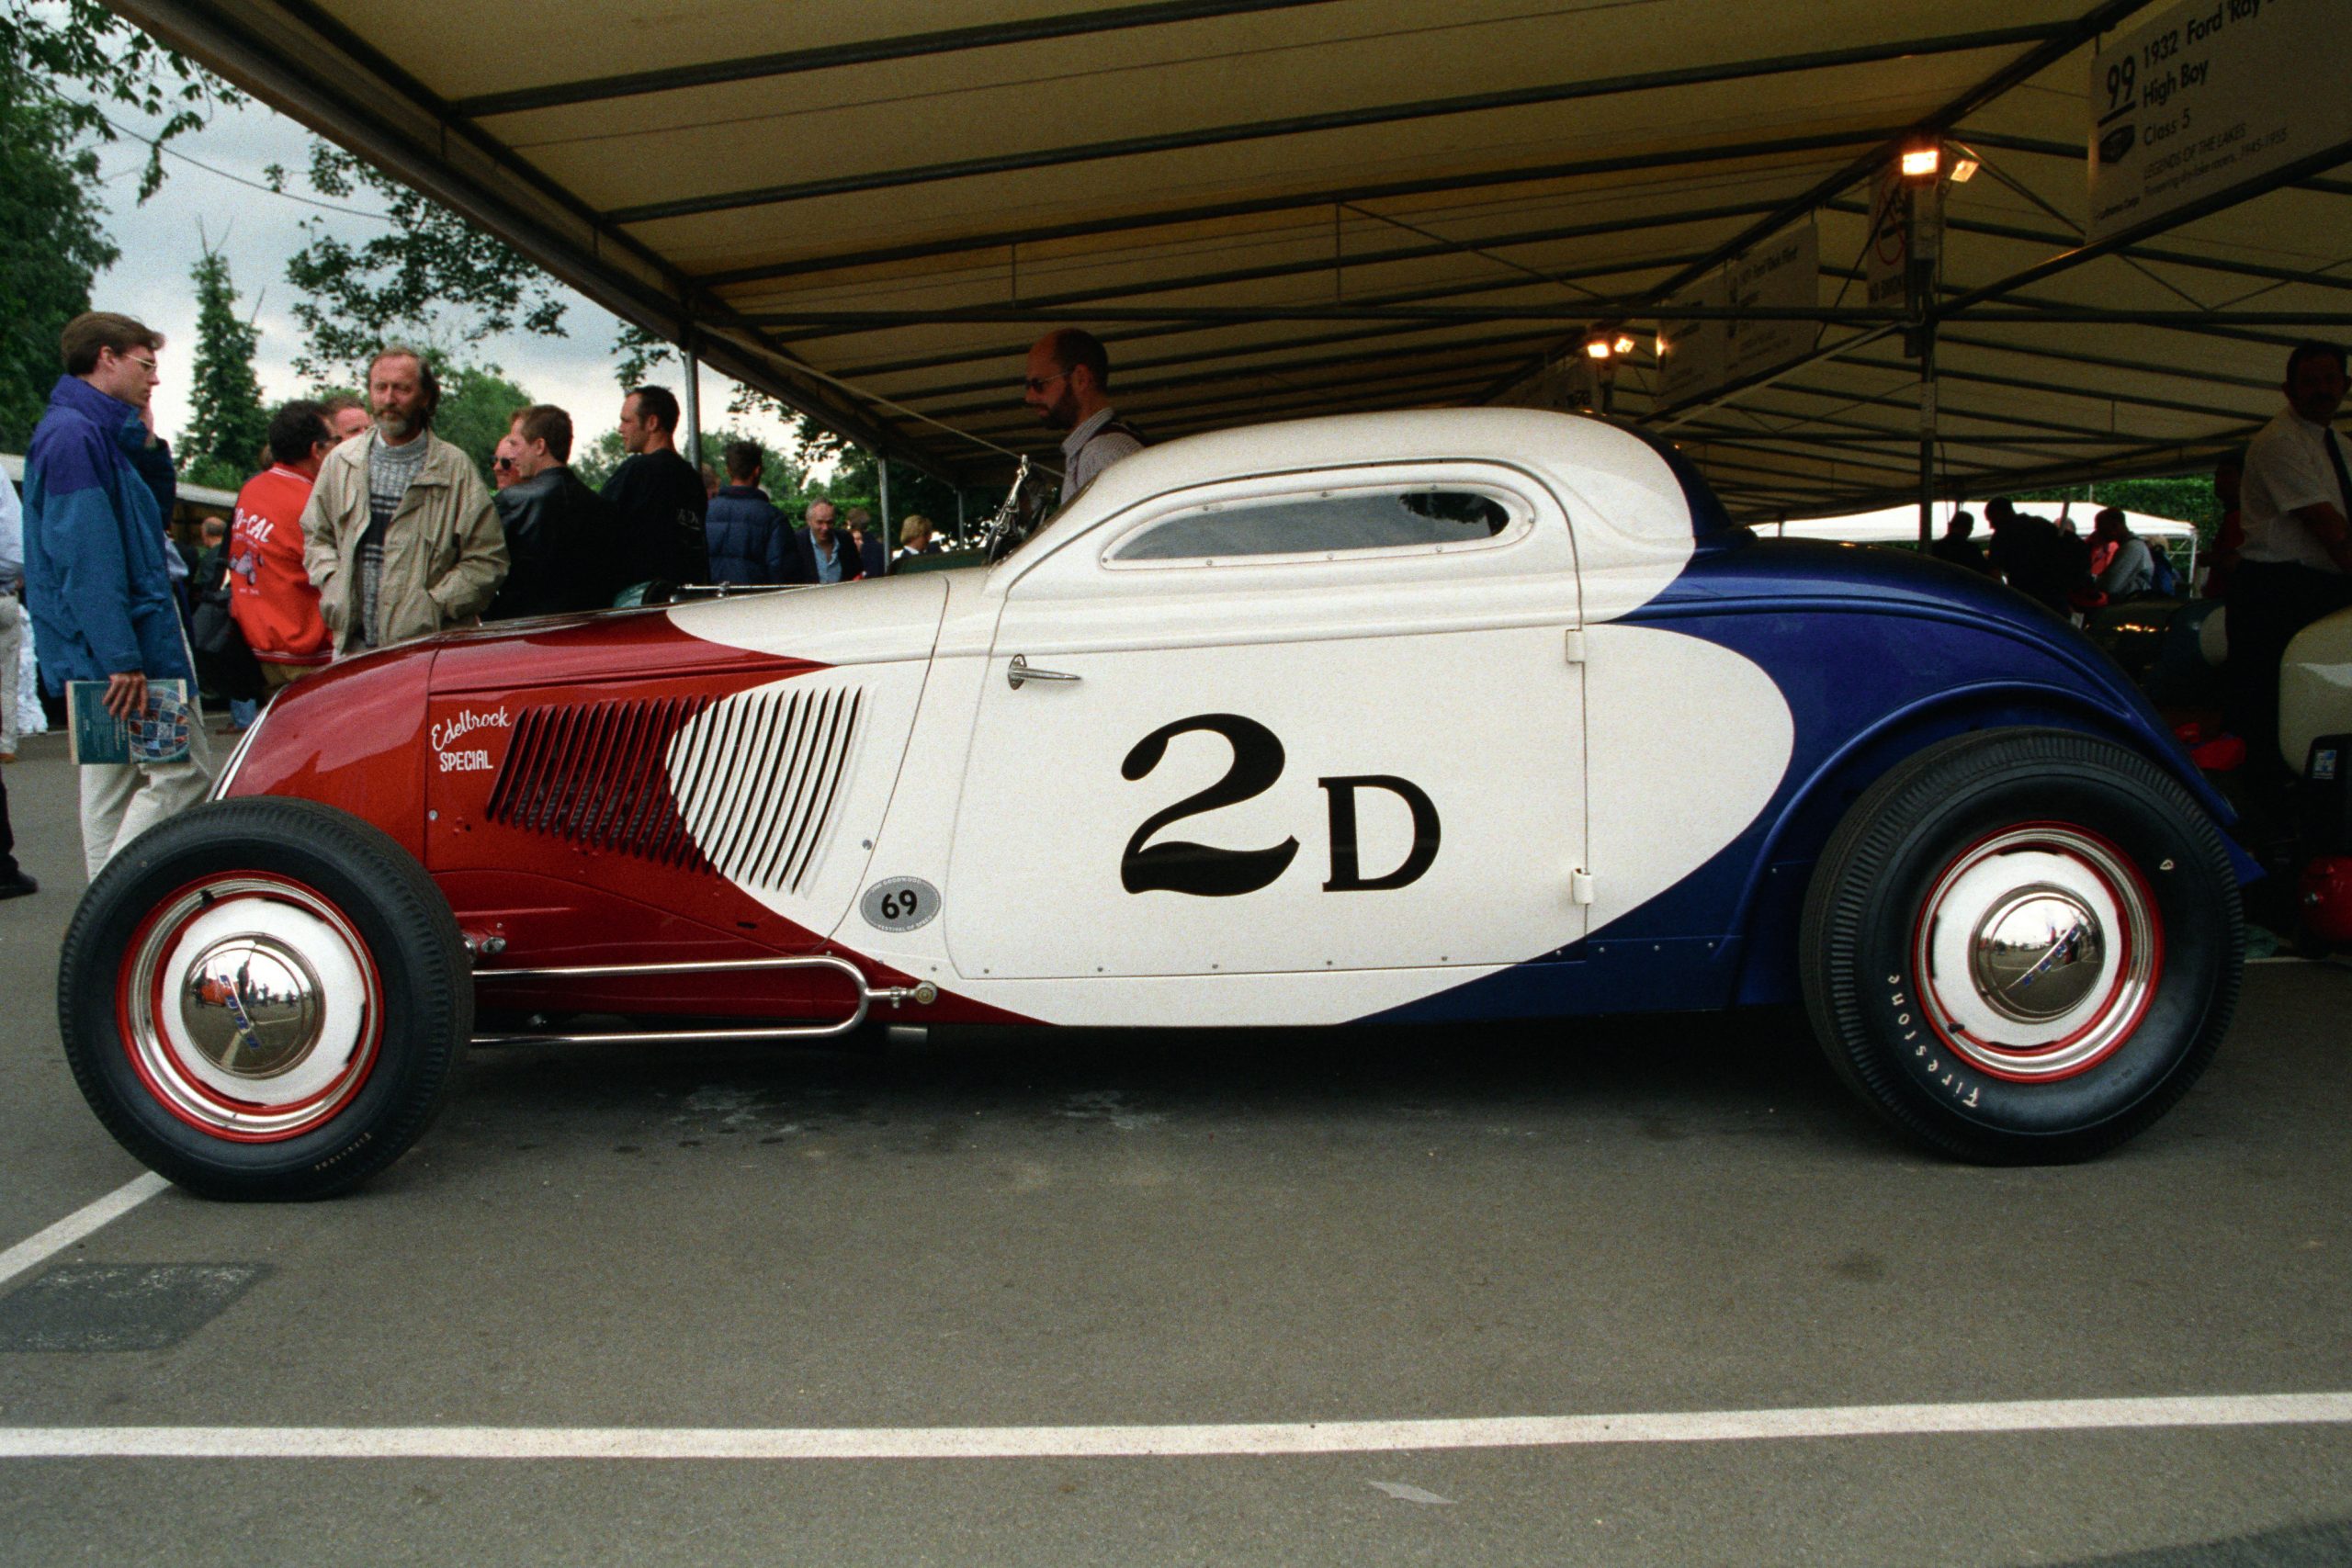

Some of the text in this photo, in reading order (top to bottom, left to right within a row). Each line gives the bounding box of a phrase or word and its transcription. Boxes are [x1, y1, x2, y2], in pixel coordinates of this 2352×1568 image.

[2143, 30, 2178, 69] 1932
[2187, 4, 2223, 44] Ford
[2107, 55, 2136, 109] 99
[2143, 60, 2209, 108] High Boy
[2143, 107, 2190, 146] Class 5
[2216, 122, 2247, 149] LAKES
[232, 507, 275, 543] O-CAL
[431, 705, 512, 751] Edelbrock
[439, 750, 493, 772] SPECIAL
[881, 889, 917, 919] 69
[1887, 975, 1979, 1108] Firestone
